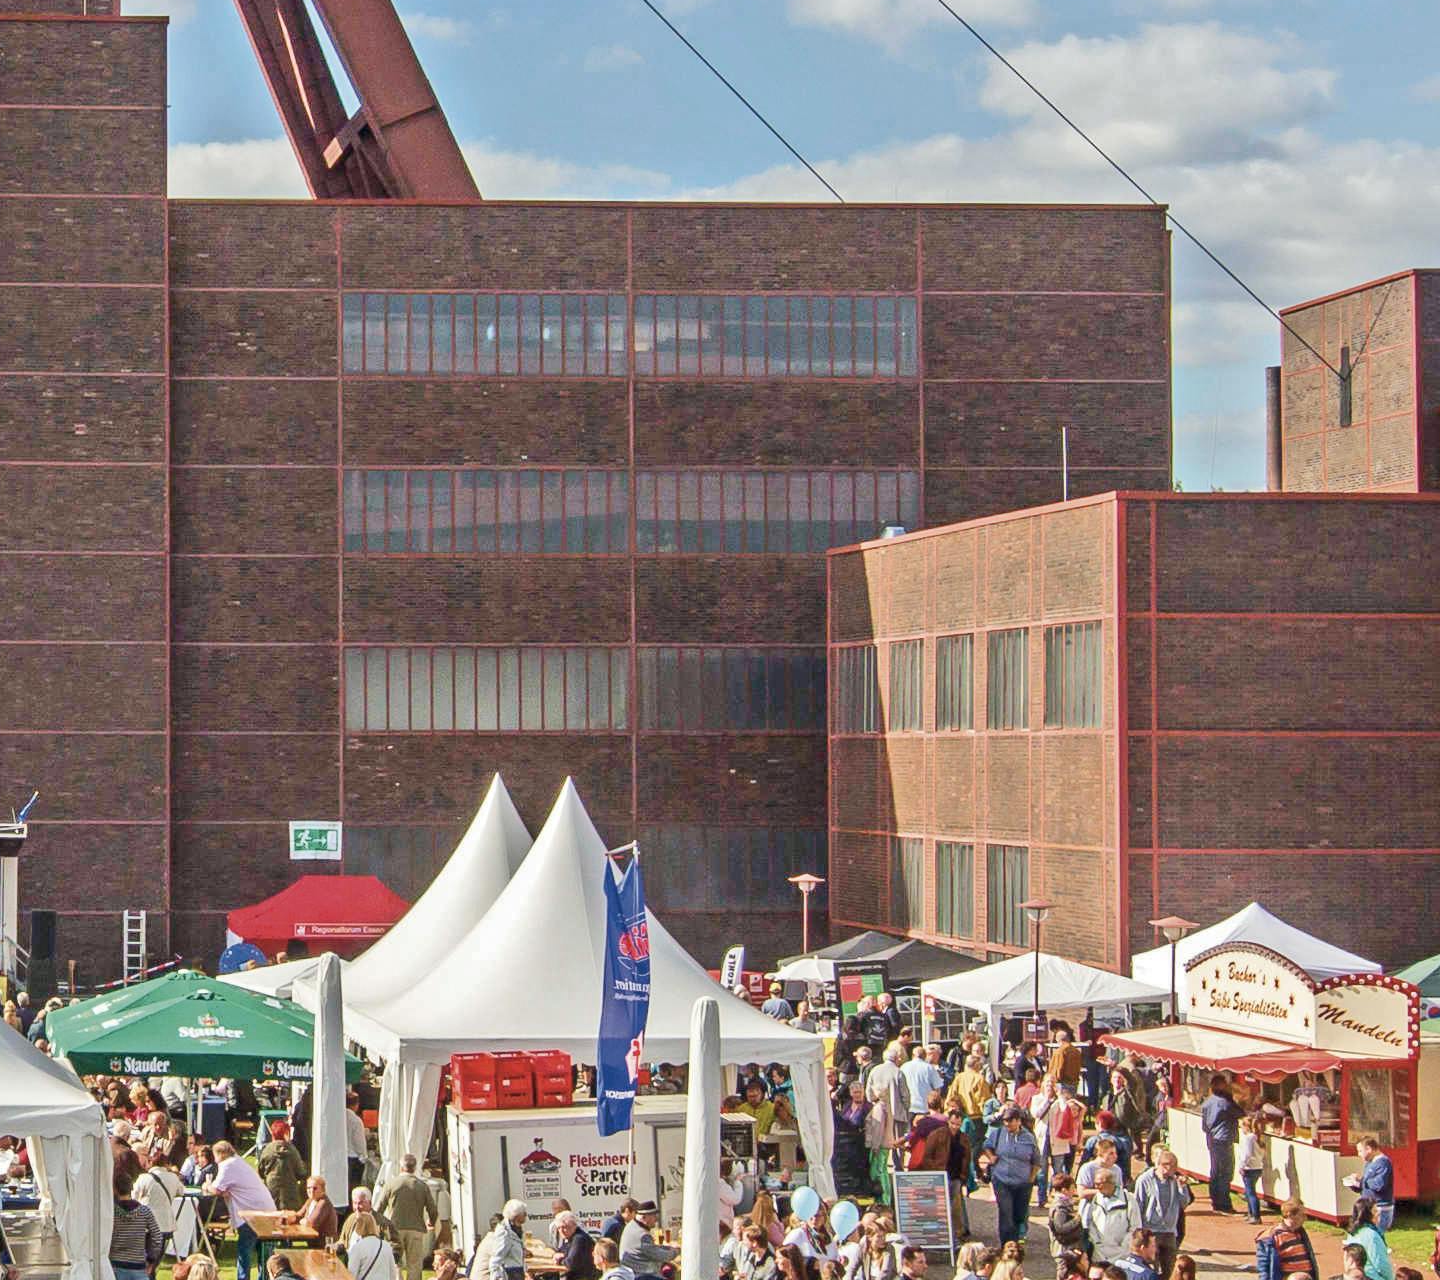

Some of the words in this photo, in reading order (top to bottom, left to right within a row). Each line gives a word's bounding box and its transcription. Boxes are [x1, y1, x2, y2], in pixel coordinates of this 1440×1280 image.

[178, 1024, 245, 1040] Stauder
[1318, 1003, 1403, 1048] Mandeln
[123, 1056, 170, 1073] Stauder
[574, 1169, 589, 1184] &
[590, 1169, 627, 1184] Party
[581, 1184, 628, 1197] Service
